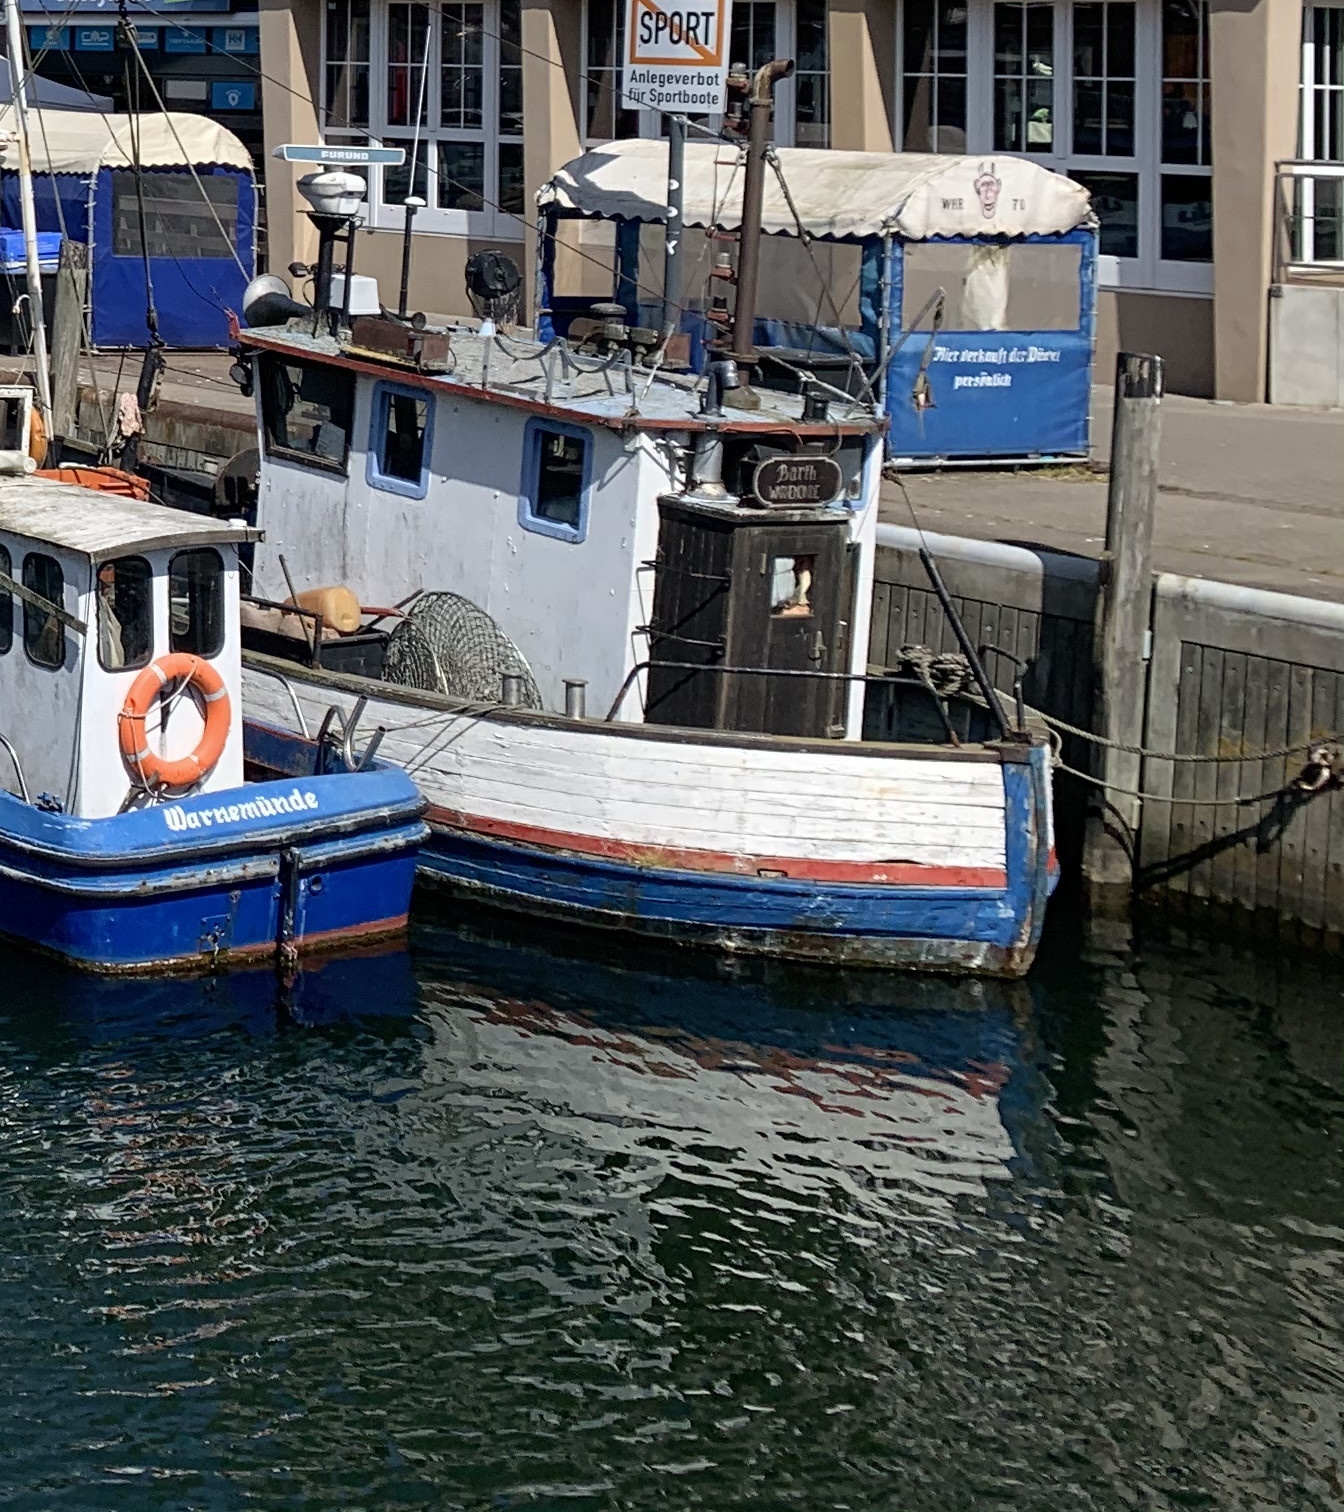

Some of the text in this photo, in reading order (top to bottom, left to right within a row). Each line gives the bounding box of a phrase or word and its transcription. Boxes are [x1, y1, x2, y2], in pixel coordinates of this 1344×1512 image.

[640, 10, 715, 45] SPORT
[630, 69, 720, 88] Anlegeverbot
[628, 88, 719, 105] für Sportboote
[320, 150, 369, 160] FURUNO
[163, 788, 319, 832] Warnemünde
